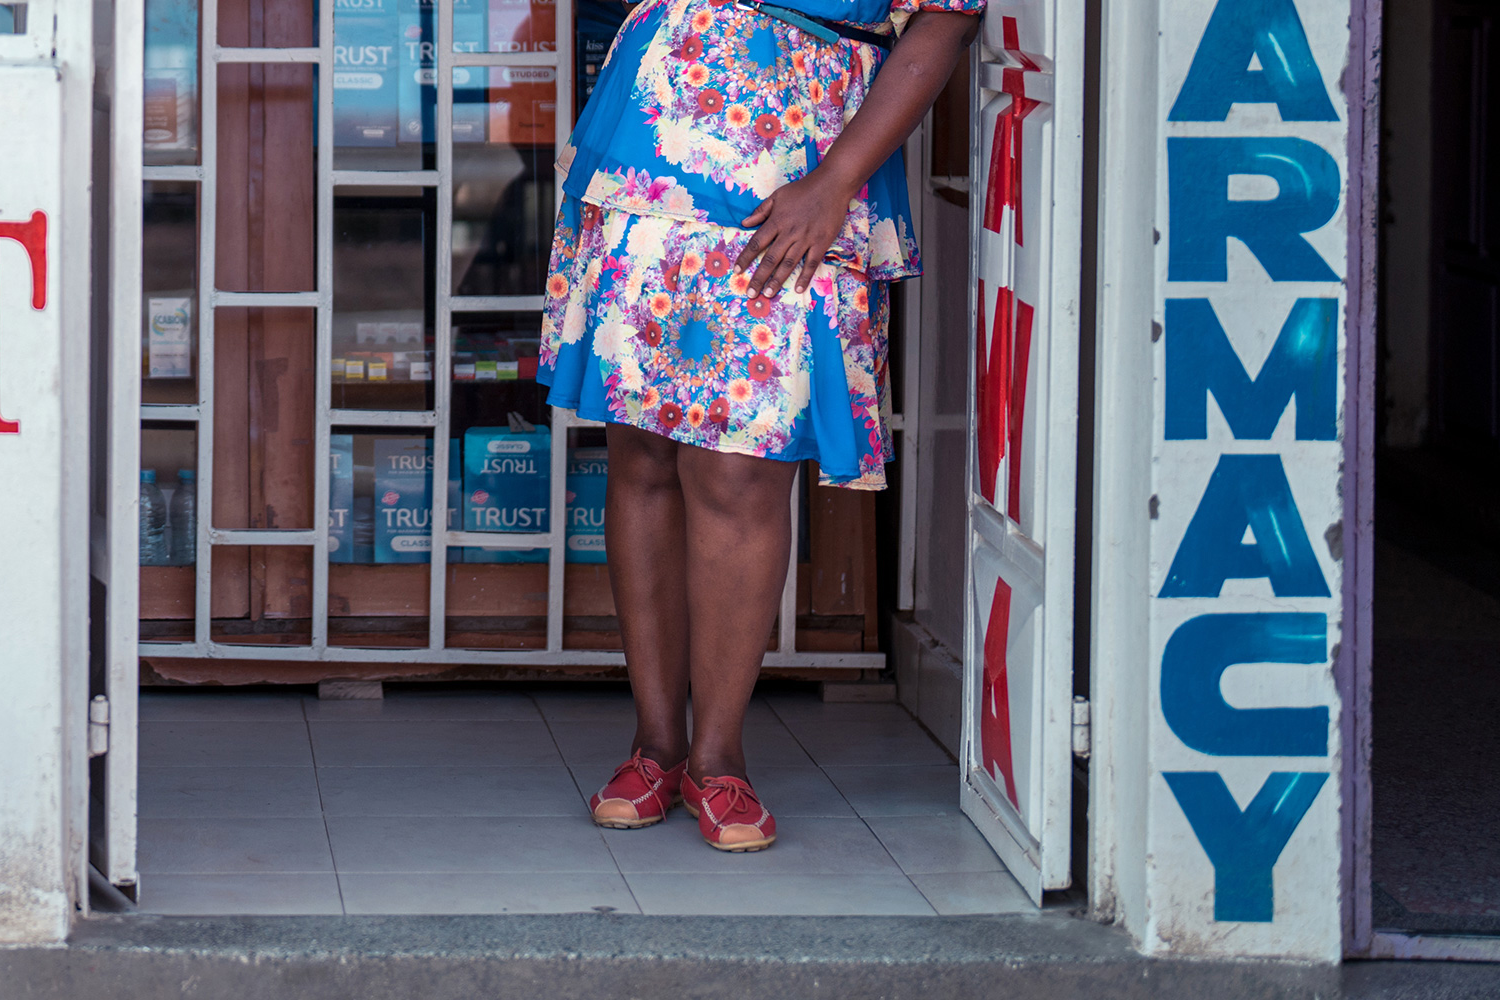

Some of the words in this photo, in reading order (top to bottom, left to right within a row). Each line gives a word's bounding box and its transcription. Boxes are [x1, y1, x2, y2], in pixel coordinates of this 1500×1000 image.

[586, 40, 604, 50] kiss
[480, 459, 537, 474] TRUST
[471, 507, 547, 527] TRUST
